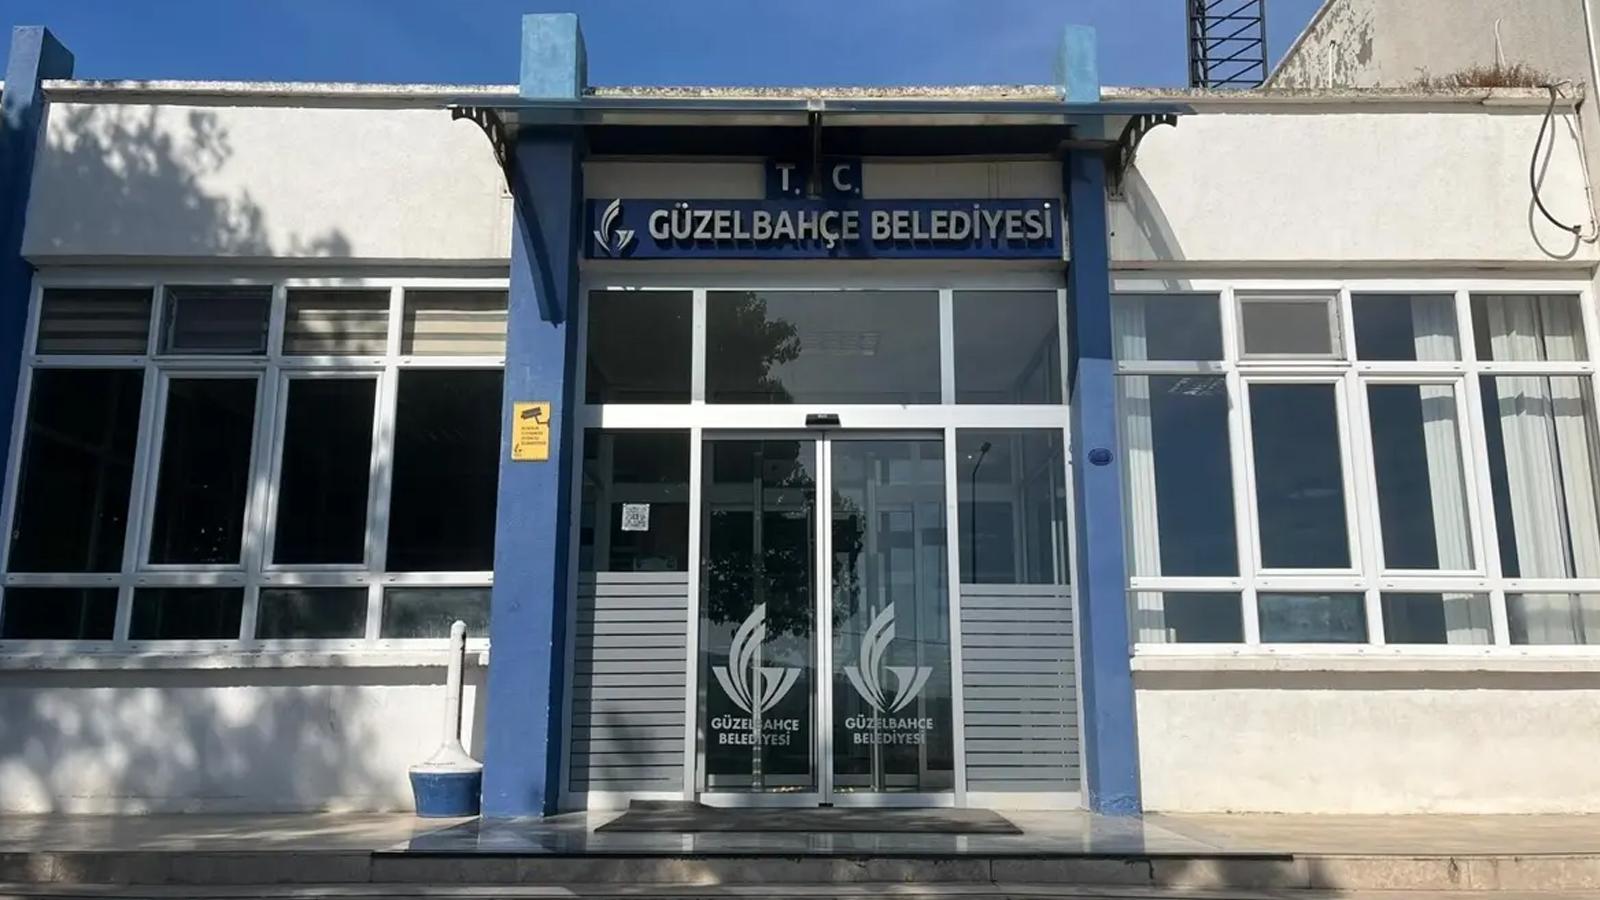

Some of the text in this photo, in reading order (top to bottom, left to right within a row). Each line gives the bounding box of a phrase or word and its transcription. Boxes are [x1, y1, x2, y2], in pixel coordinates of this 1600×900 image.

[775, 163, 860, 195] T. C.
[648, 202, 1053, 249] GÜZELBAHÇE BELEDİYESİ
[853, 729, 926, 745] BELEDİYESİ
